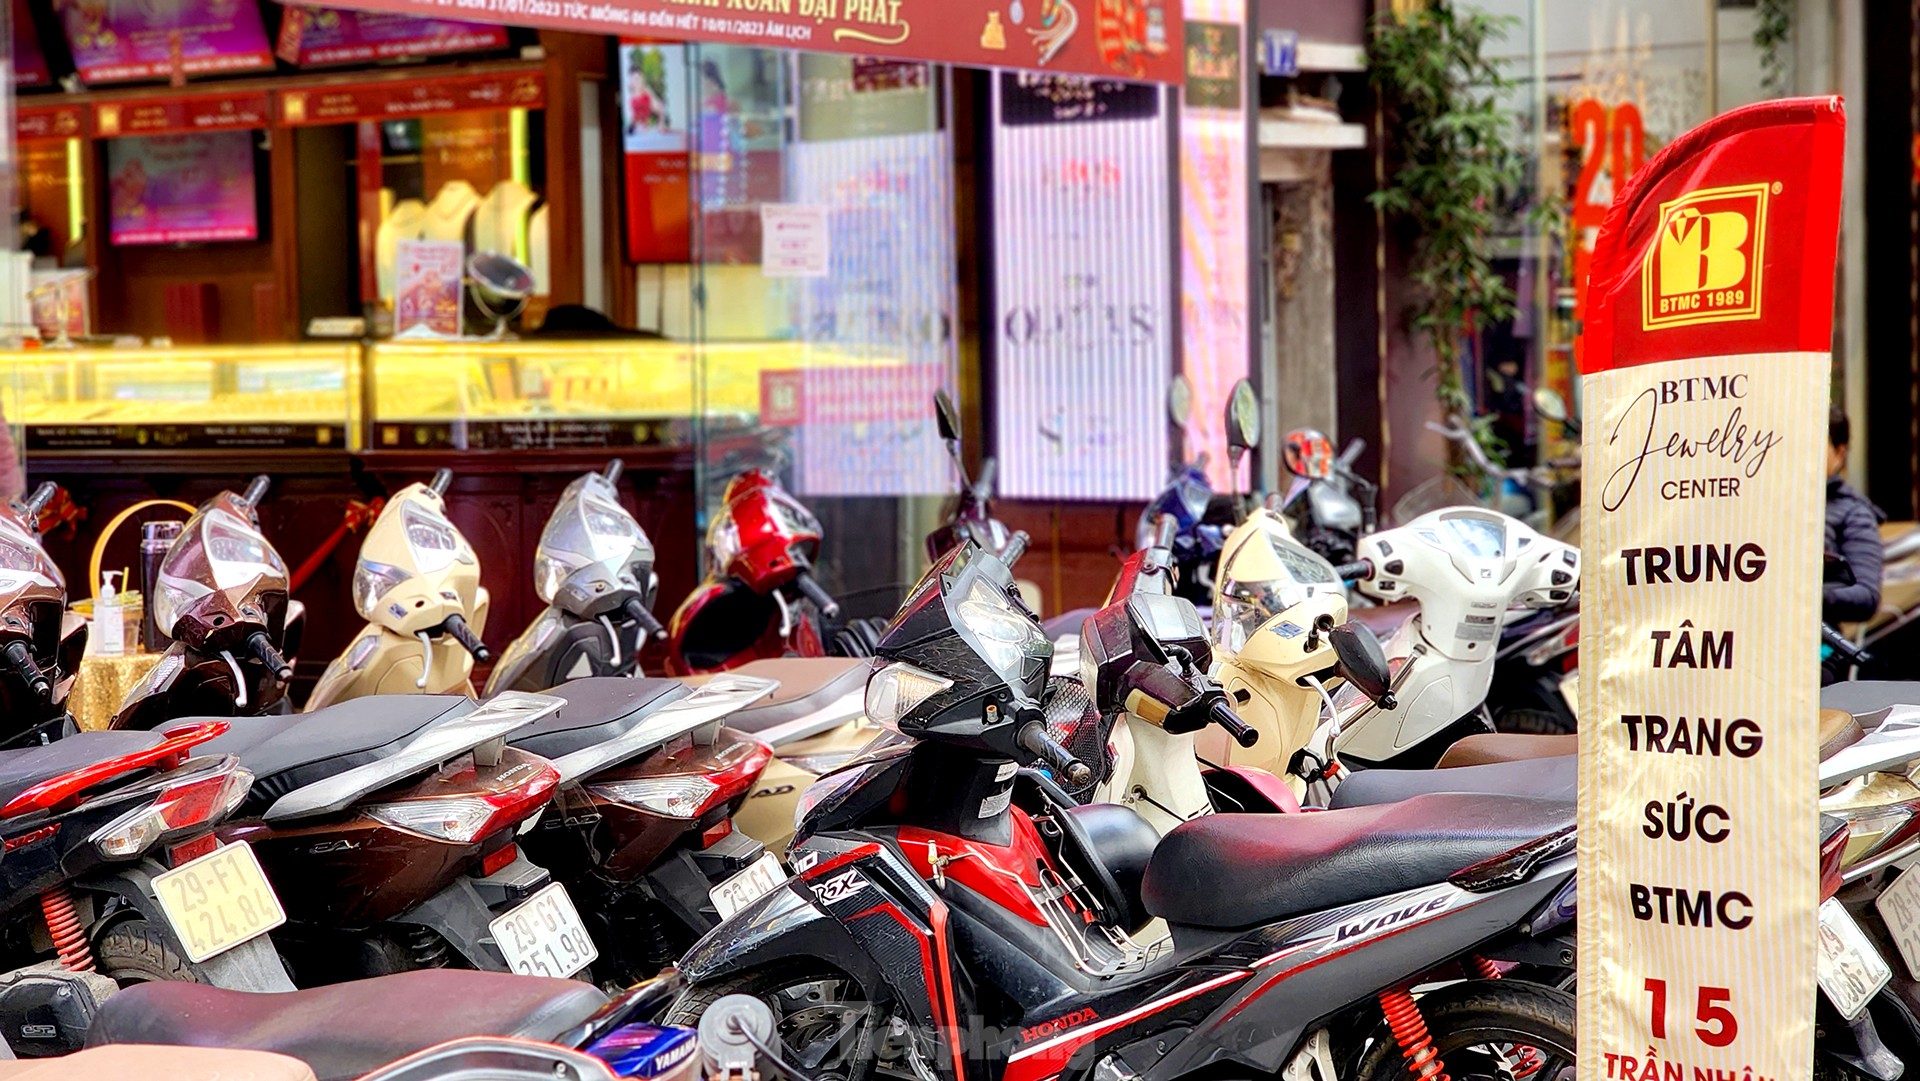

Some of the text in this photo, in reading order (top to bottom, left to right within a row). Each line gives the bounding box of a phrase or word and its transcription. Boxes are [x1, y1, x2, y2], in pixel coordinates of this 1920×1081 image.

[1659, 289, 1745, 314] BTMC 1989
[1658, 373, 1749, 405] BTMC
[1601, 386, 1784, 512] Jewelry
[1660, 476, 1741, 501] CENTER
[1620, 542, 1767, 586] TRUNG
[1650, 618, 1734, 670] TÂM
[1620, 714, 1763, 759] TRANG
[496, 761, 532, 782] HONDA
[1641, 790, 1731, 844] SỨC
[170, 853, 248, 913] 29-F1
[184, 887, 275, 952] 424.84
[504, 894, 567, 954] 29-G1
[1629, 882, 1754, 930] BTMC
[1020, 1006, 1100, 1044] HONDA
[1604, 1045, 1776, 1081] TRẦN NHÂ
